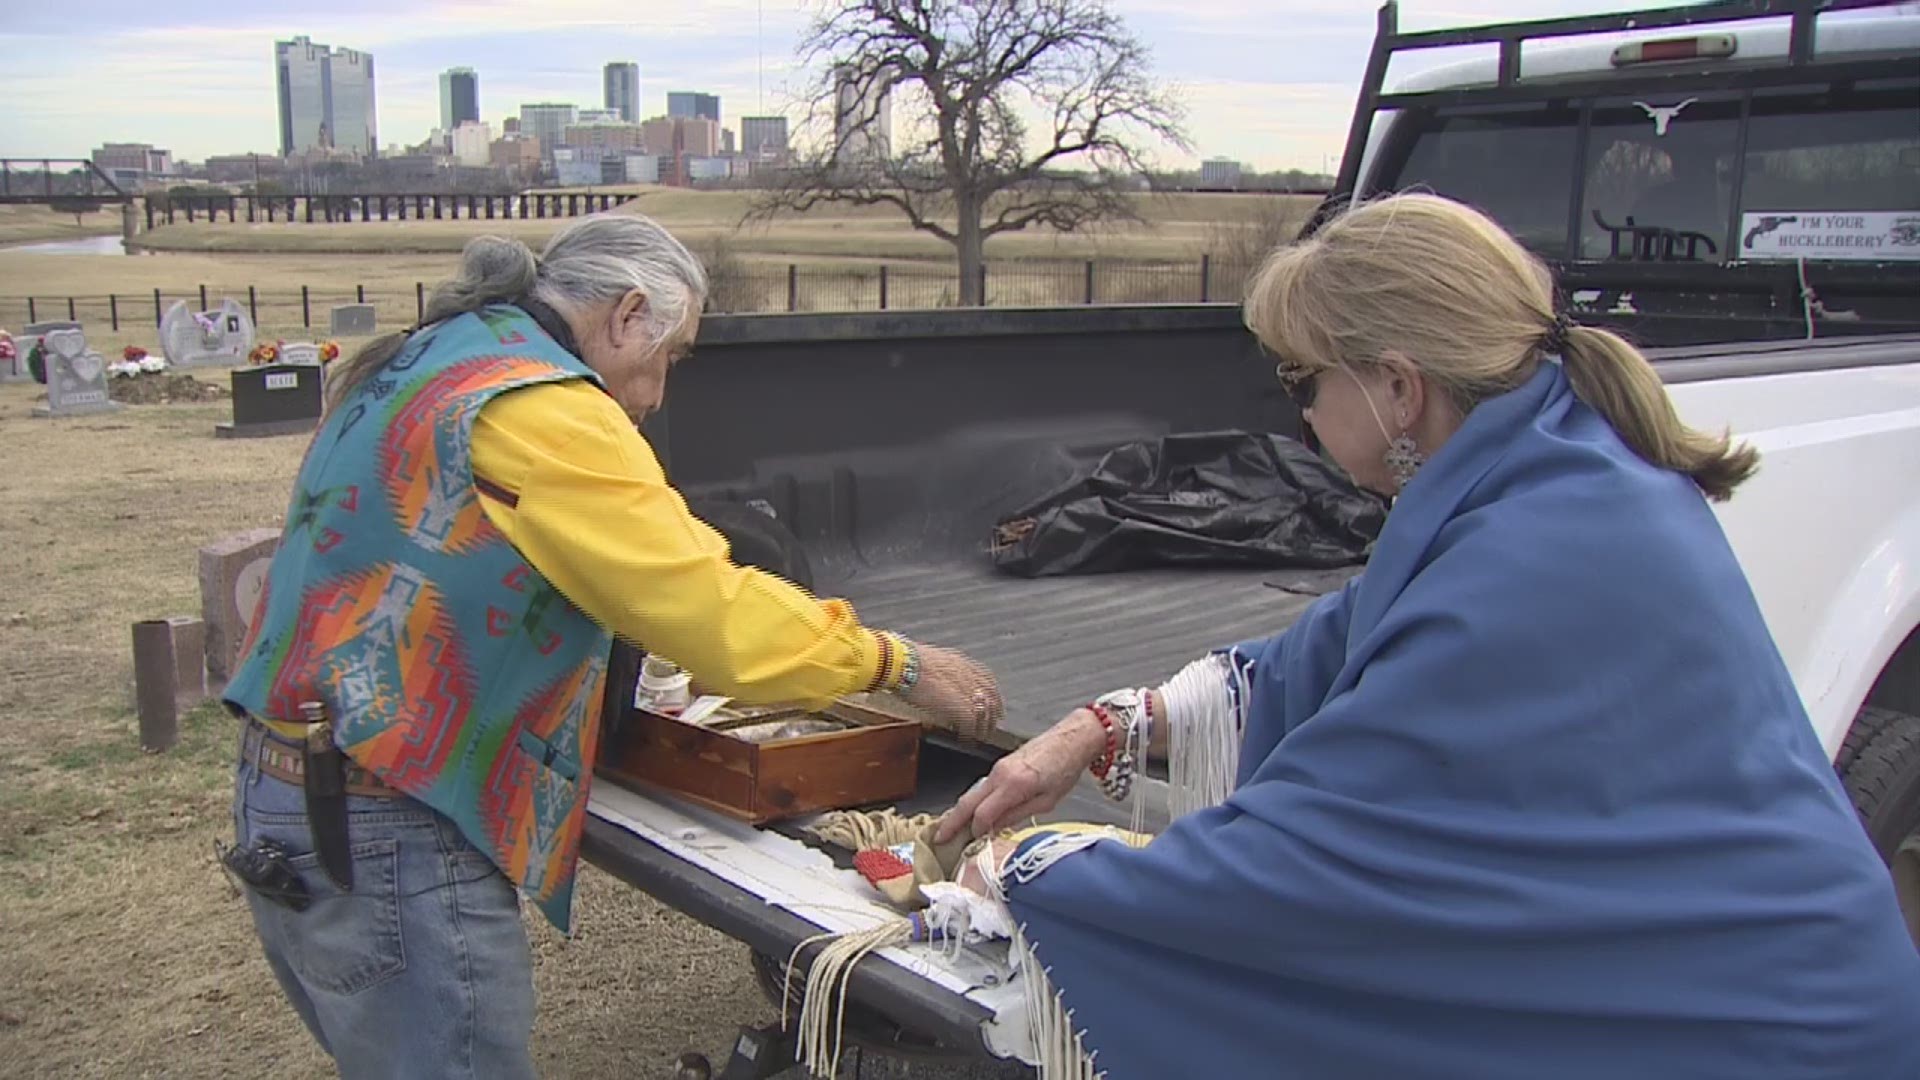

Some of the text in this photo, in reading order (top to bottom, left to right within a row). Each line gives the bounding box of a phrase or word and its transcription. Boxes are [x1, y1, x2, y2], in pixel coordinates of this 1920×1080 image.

[1801, 215, 1865, 229] I'M YOUR
[1778, 234, 1887, 248] HUCKLEBERRY
